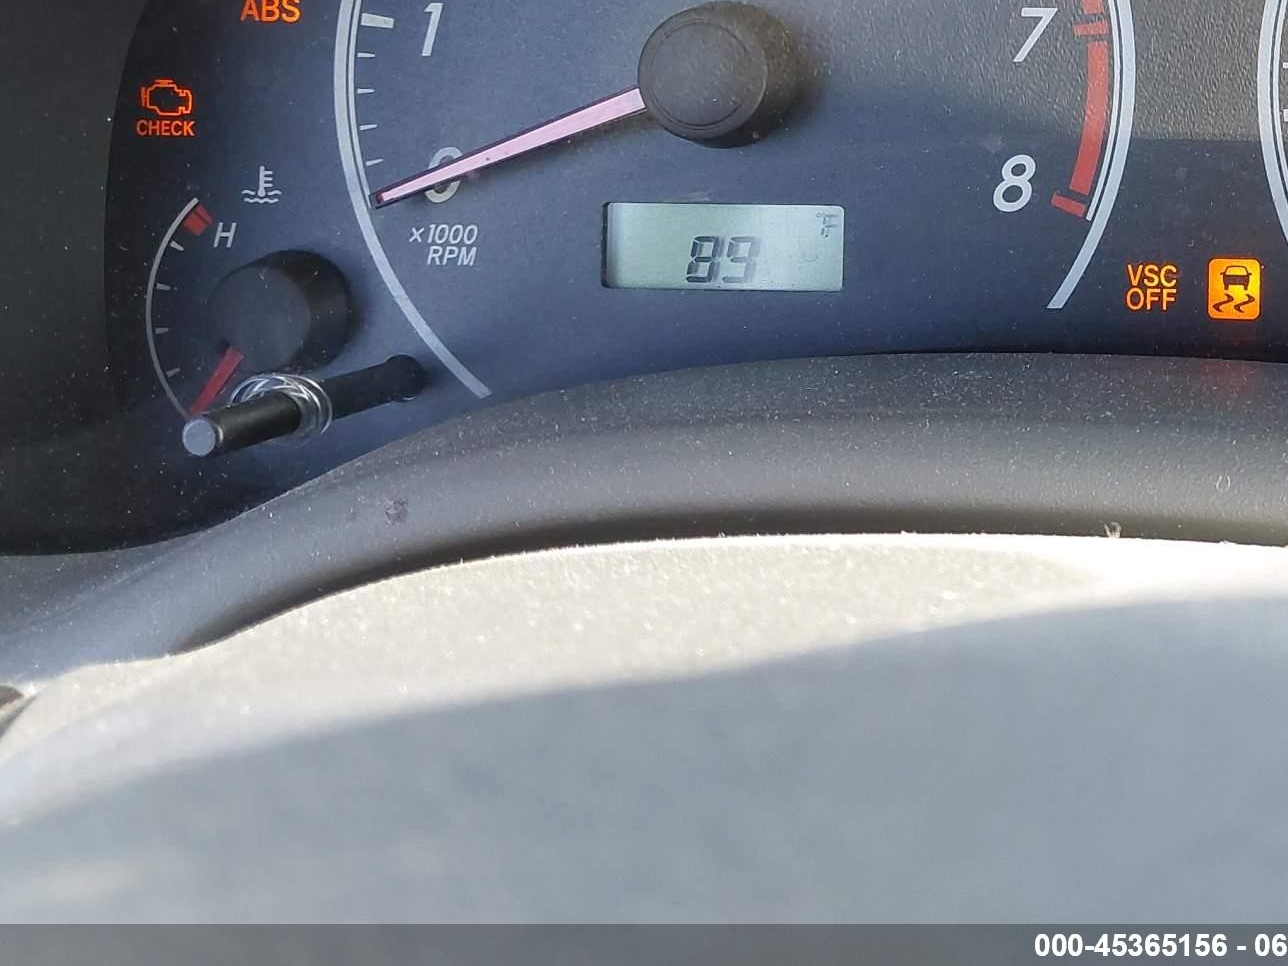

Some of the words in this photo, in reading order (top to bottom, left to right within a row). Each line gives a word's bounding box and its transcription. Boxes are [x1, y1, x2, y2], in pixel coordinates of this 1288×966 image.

[421, 2, 444, 56] 1
[1013, 8, 1057, 62] 7
[136, 120, 195, 136] CHECK
[993, 155, 1036, 212] 8
[212, 222, 237, 248] H
[427, 246, 477, 266] RPM
[686, 236, 761, 283] 89
[1127, 264, 1177, 287] VSC
[1126, 288, 1176, 312] OFF
